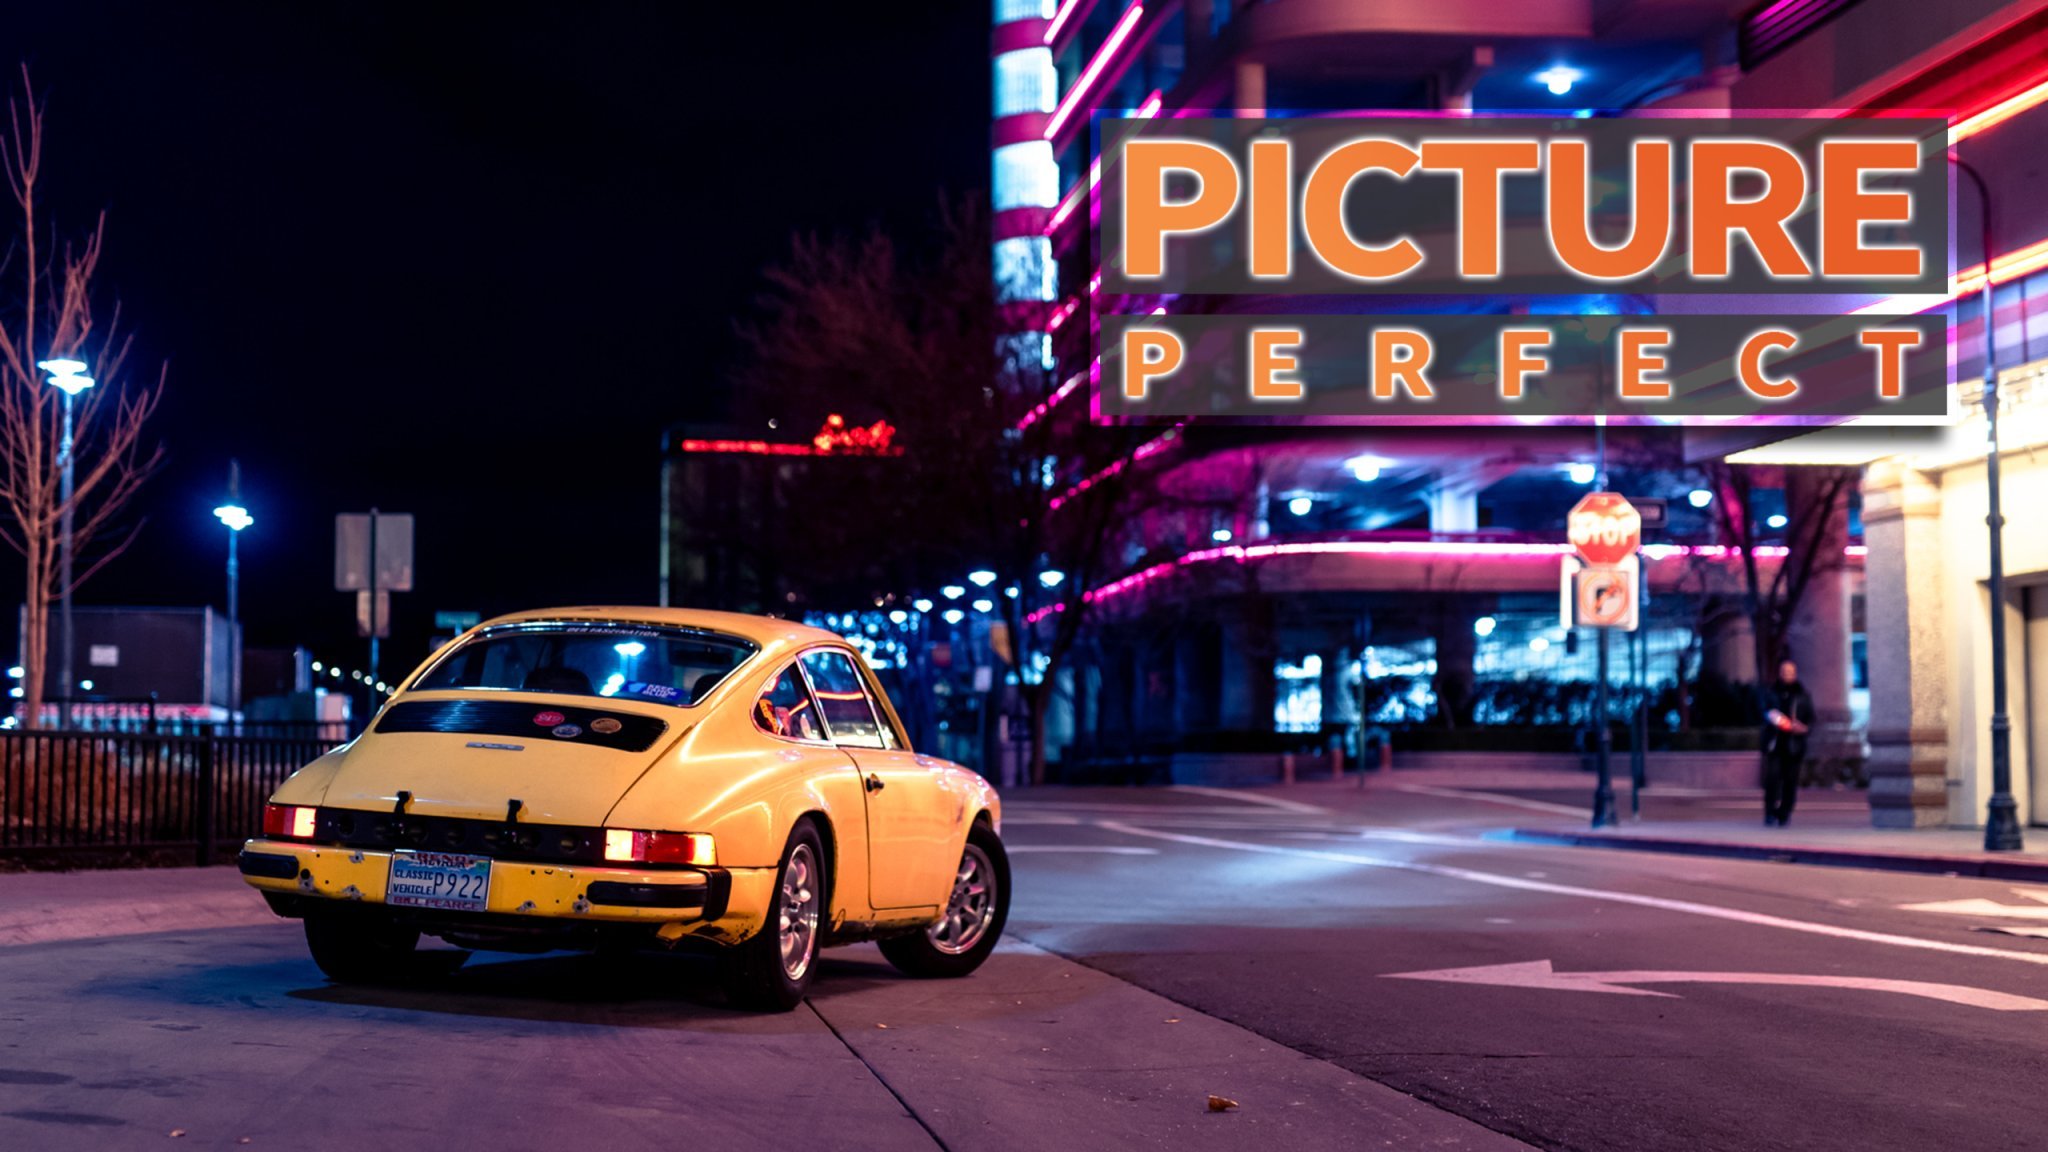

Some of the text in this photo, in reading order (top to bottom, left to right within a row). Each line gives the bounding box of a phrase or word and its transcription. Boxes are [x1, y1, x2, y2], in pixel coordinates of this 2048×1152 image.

[1569, 512, 1638, 546] STOP
[393, 884, 432, 895] VEHICLE
[394, 869, 484, 899] CLASSIC P922
